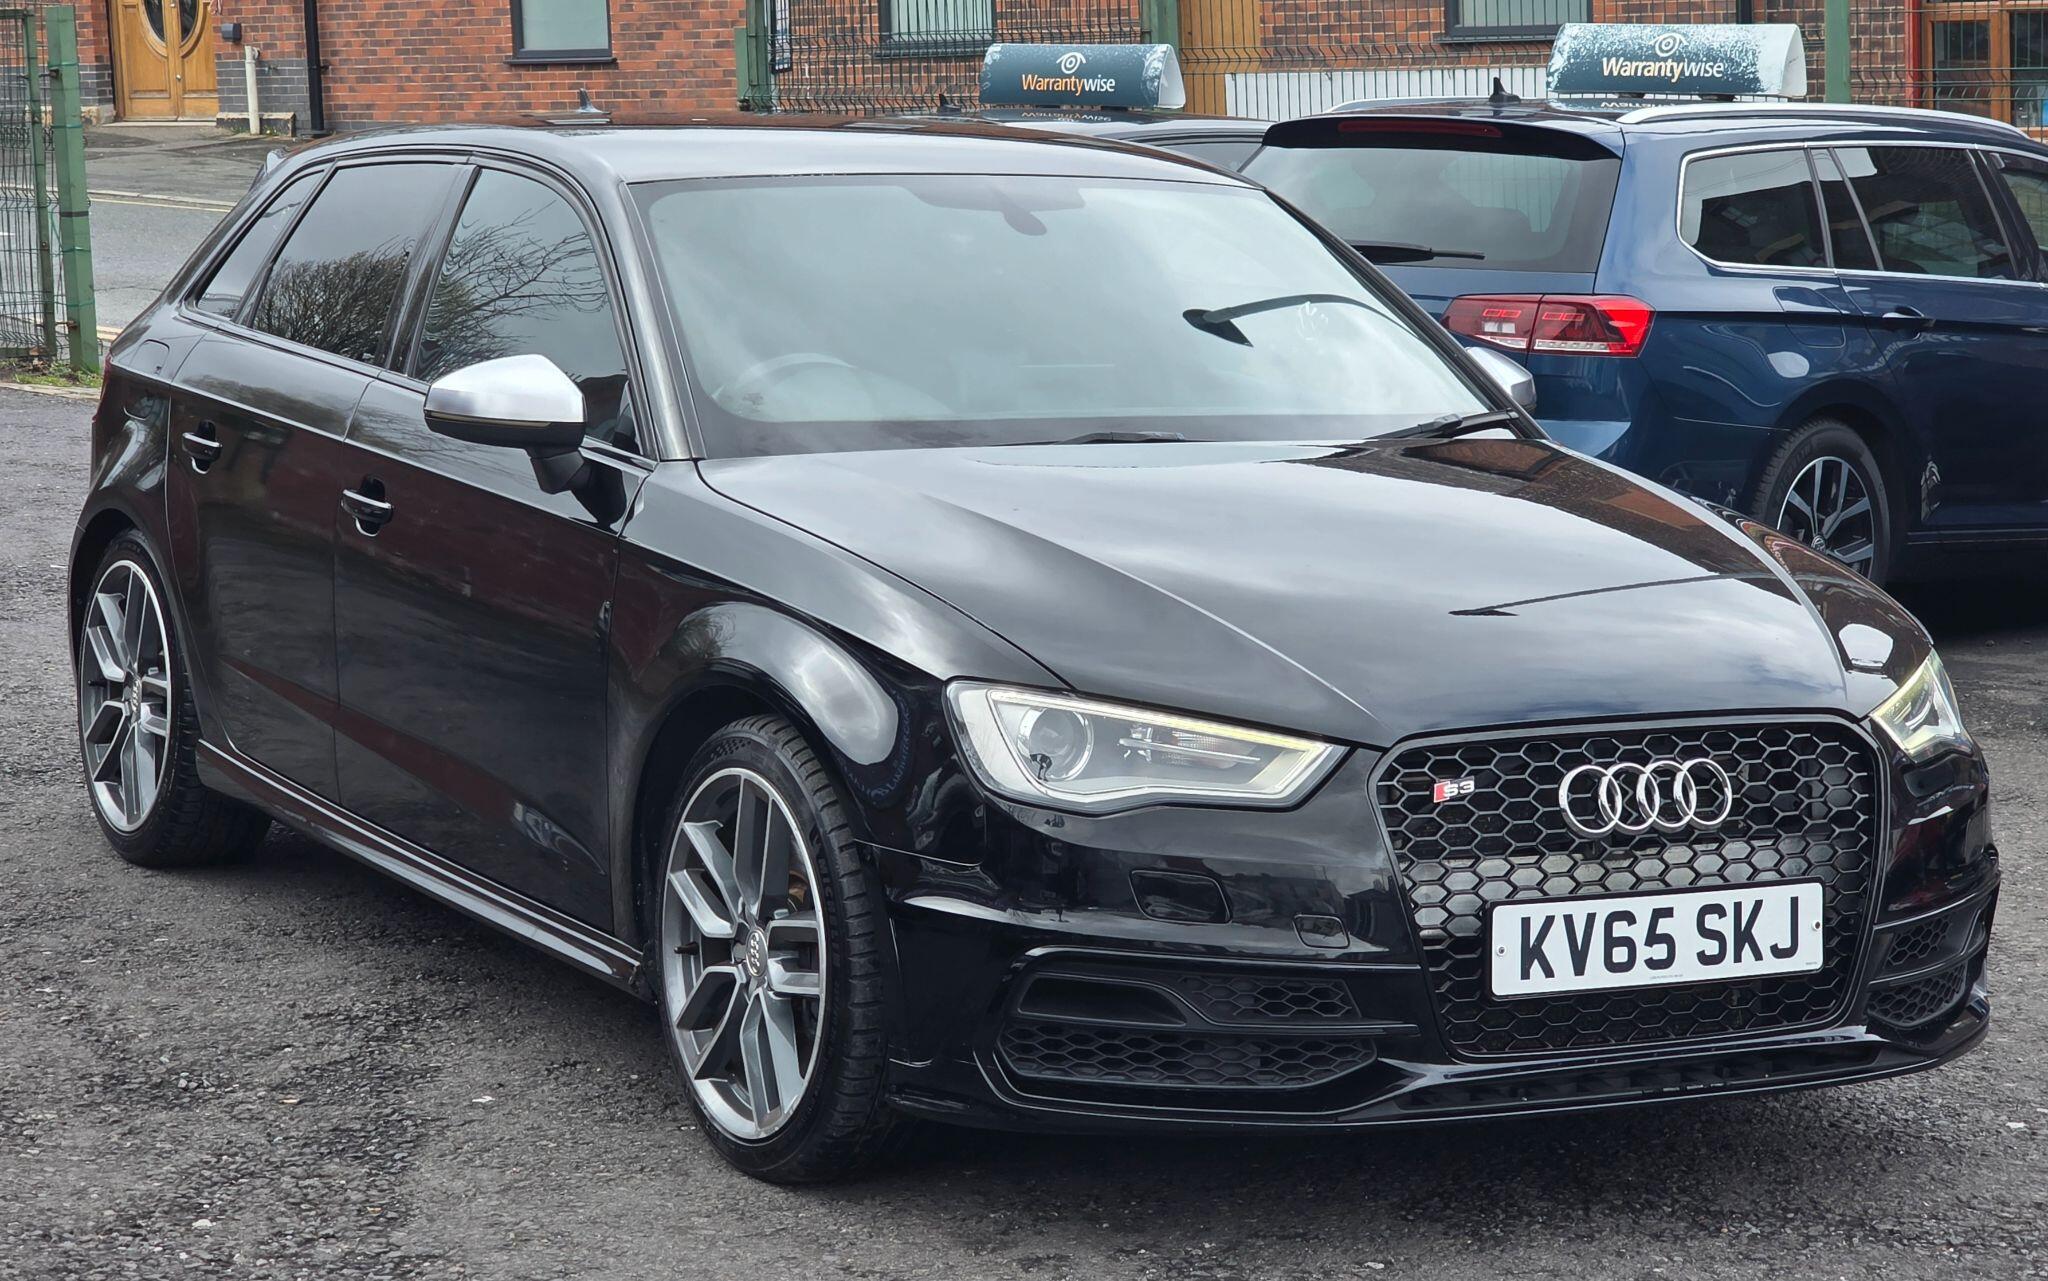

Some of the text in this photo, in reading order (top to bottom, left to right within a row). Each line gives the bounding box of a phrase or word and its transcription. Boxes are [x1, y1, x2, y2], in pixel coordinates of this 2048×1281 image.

[1602, 57, 1725, 82] Warrantywise
[1021, 74, 1115, 96] Warrantywise
[1443, 779, 1475, 798] S3
[1520, 896, 1799, 980] KV65 SKJ
